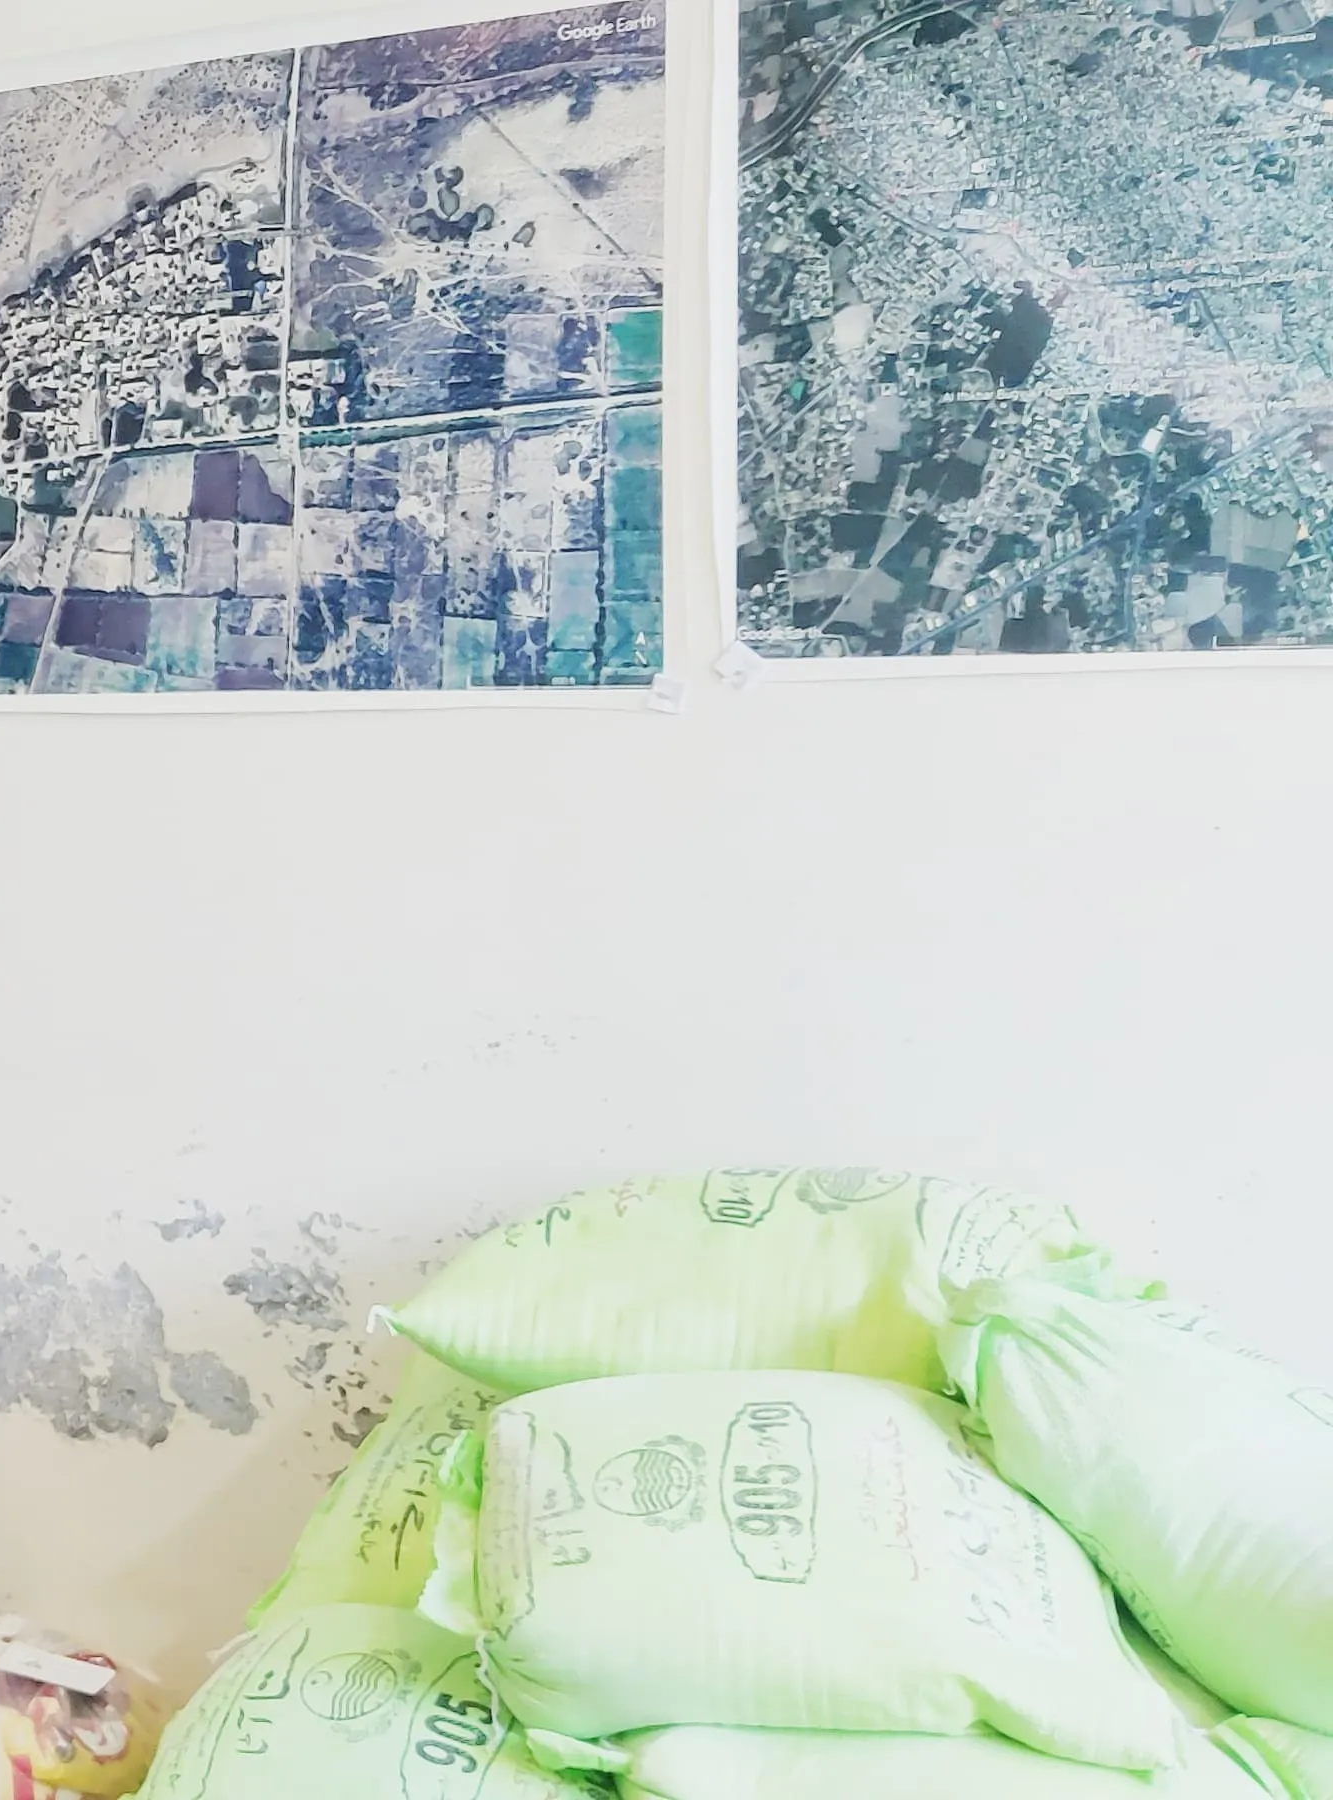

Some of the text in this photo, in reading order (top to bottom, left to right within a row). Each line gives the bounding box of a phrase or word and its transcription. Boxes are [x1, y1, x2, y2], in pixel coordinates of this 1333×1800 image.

[557, 13, 657, 42] Google Earth
[747, 1406, 791, 1434] 10
[733, 1463, 804, 1538] 905
[414, 1691, 494, 1774] 905
